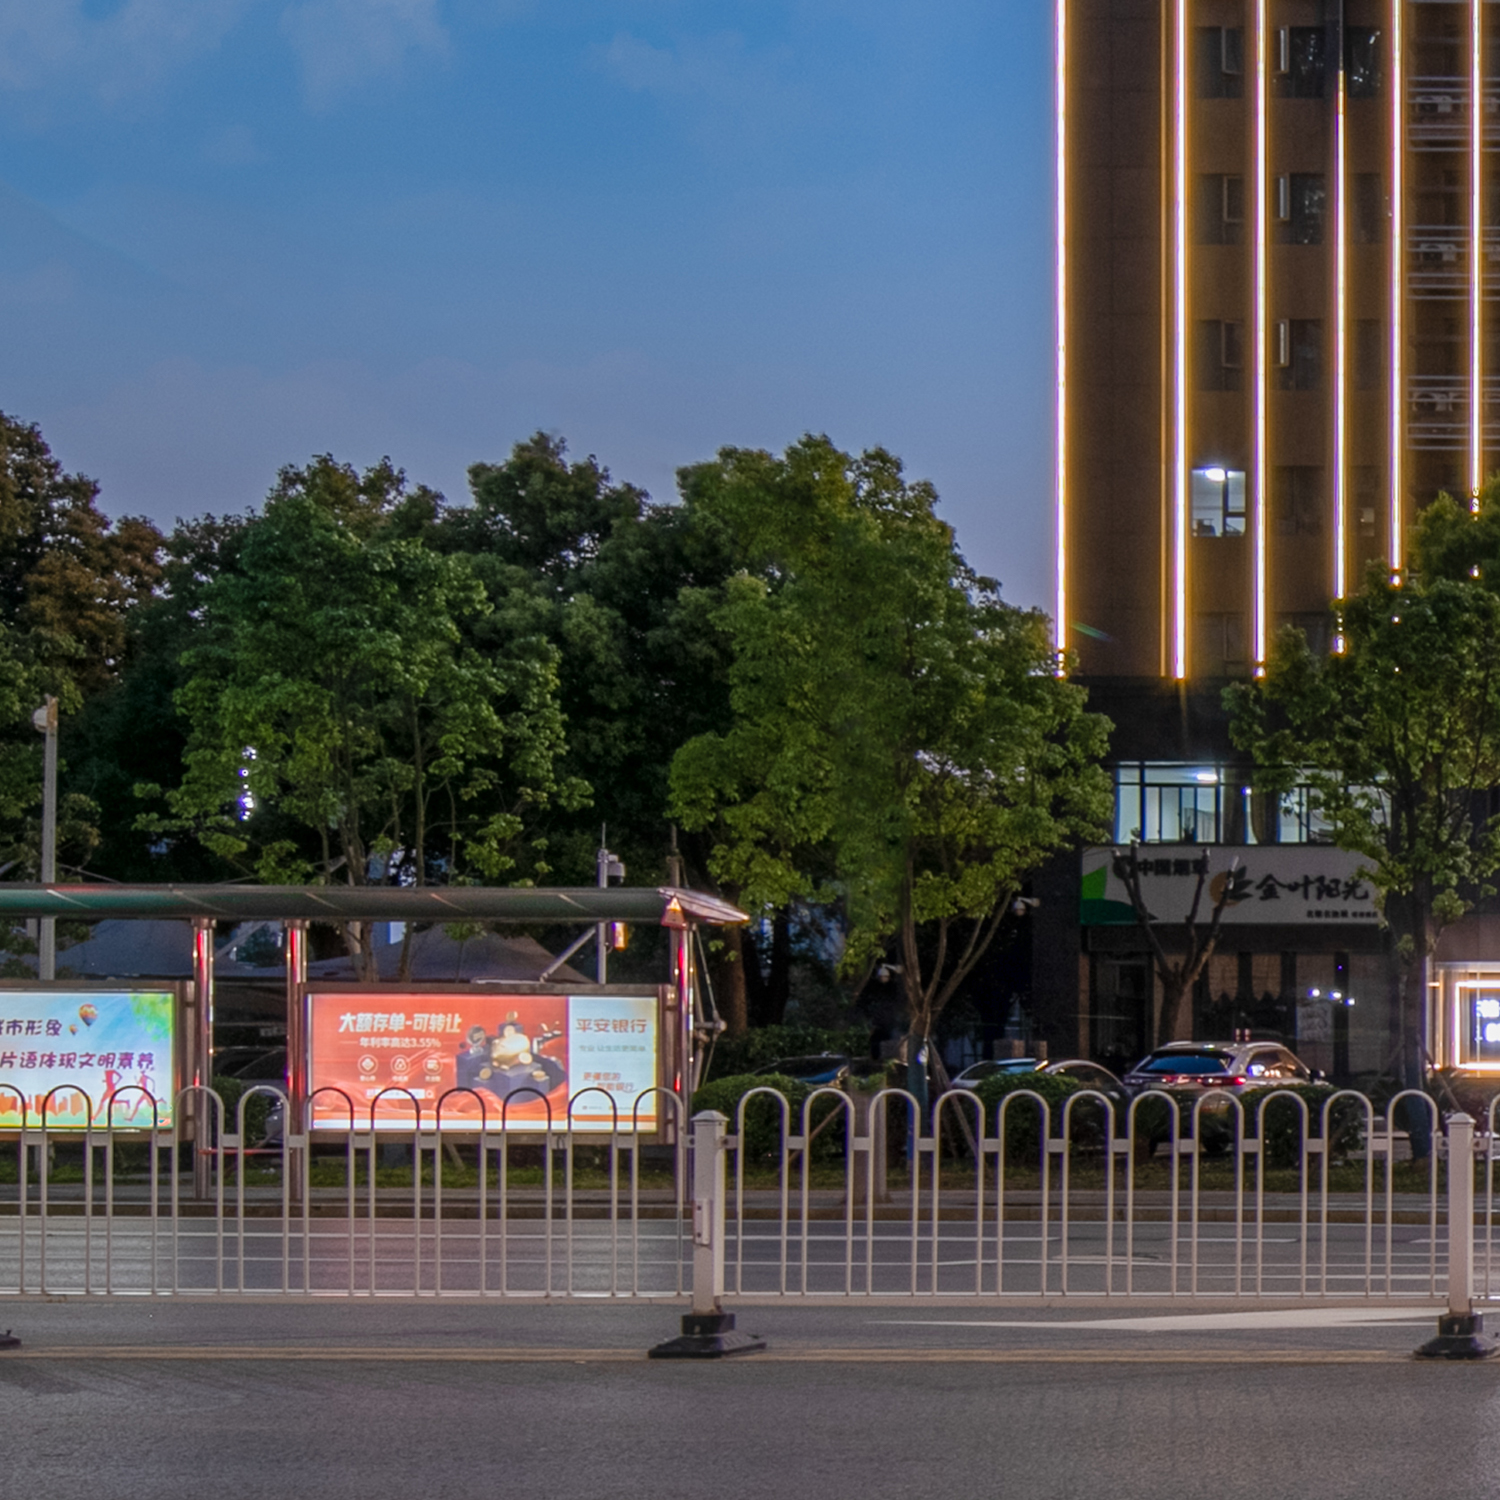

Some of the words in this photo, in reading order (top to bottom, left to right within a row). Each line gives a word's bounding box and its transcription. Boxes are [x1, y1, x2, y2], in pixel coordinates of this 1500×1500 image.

[1256, 873, 1369, 901] 金叶阳光
[0, 1019, 63, 1037] 市形象
[338, 1012, 463, 1033] 大额存单-可转让
[576, 1018, 647, 1034] 平安银行
